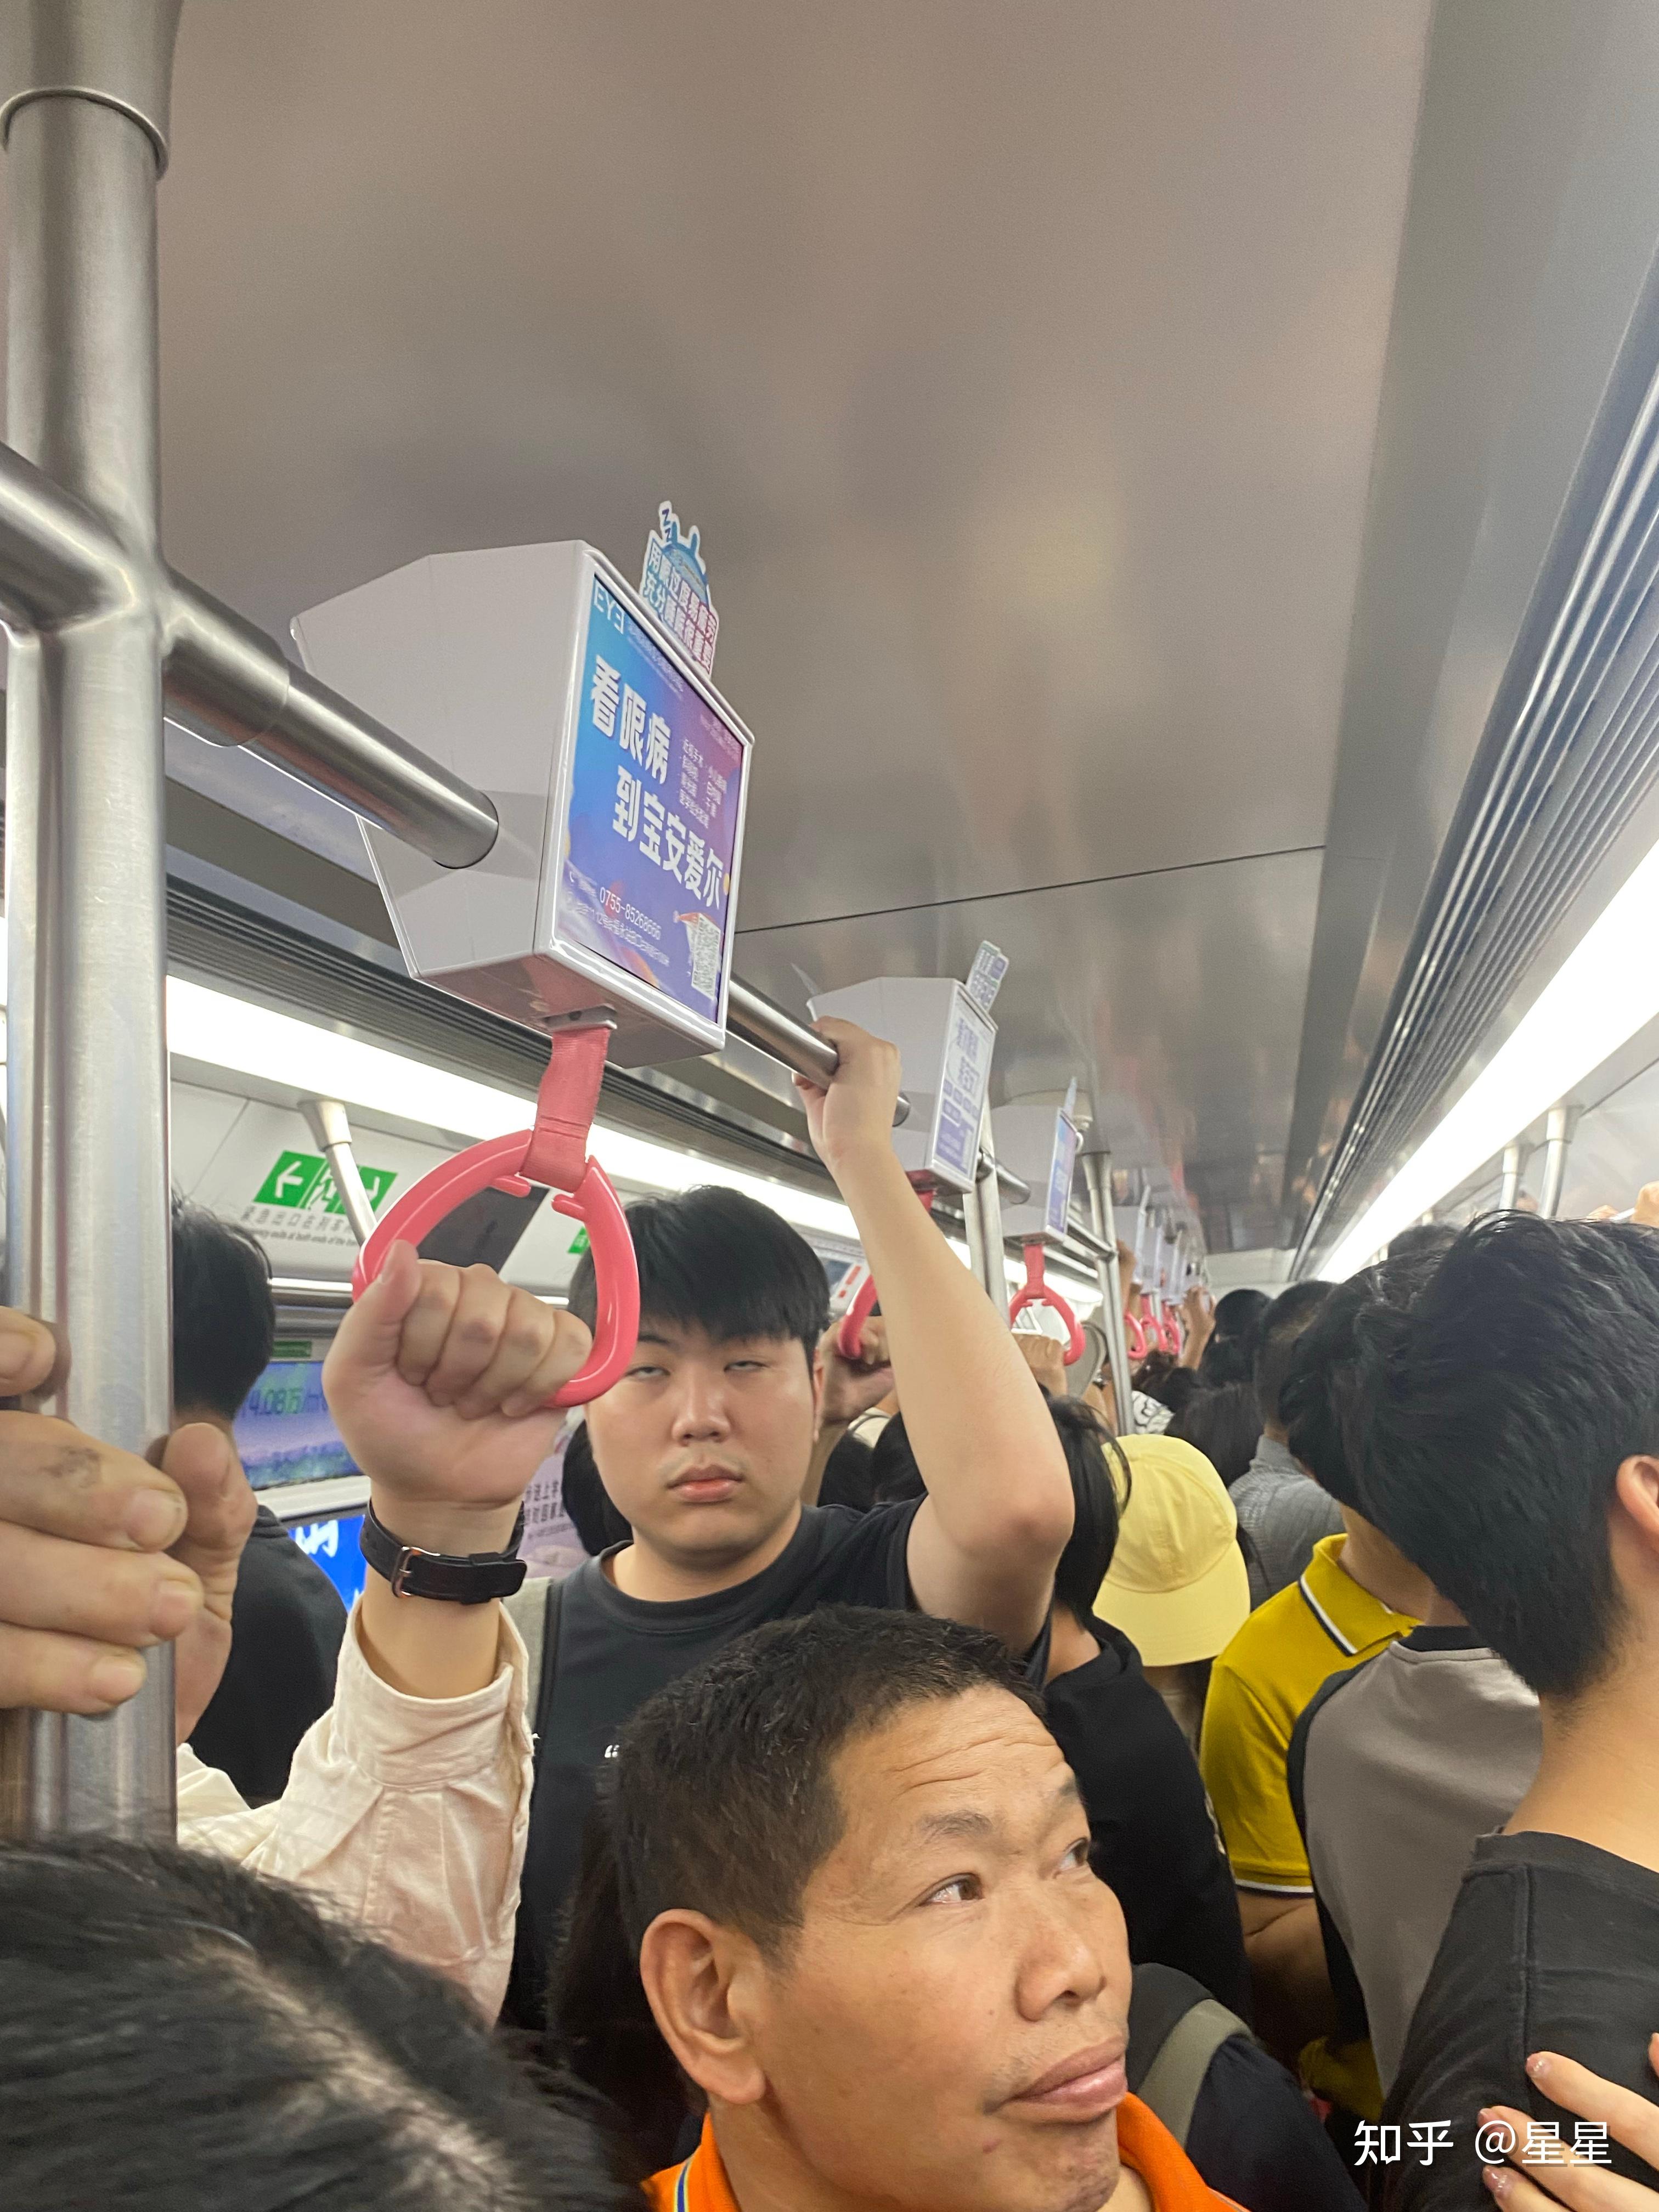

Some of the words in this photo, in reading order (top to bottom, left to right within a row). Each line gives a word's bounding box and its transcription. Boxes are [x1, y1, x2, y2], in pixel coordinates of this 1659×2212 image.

[590, 653, 672, 786] 看眼病
[612, 764, 724, 911] 到宝安爱尔
